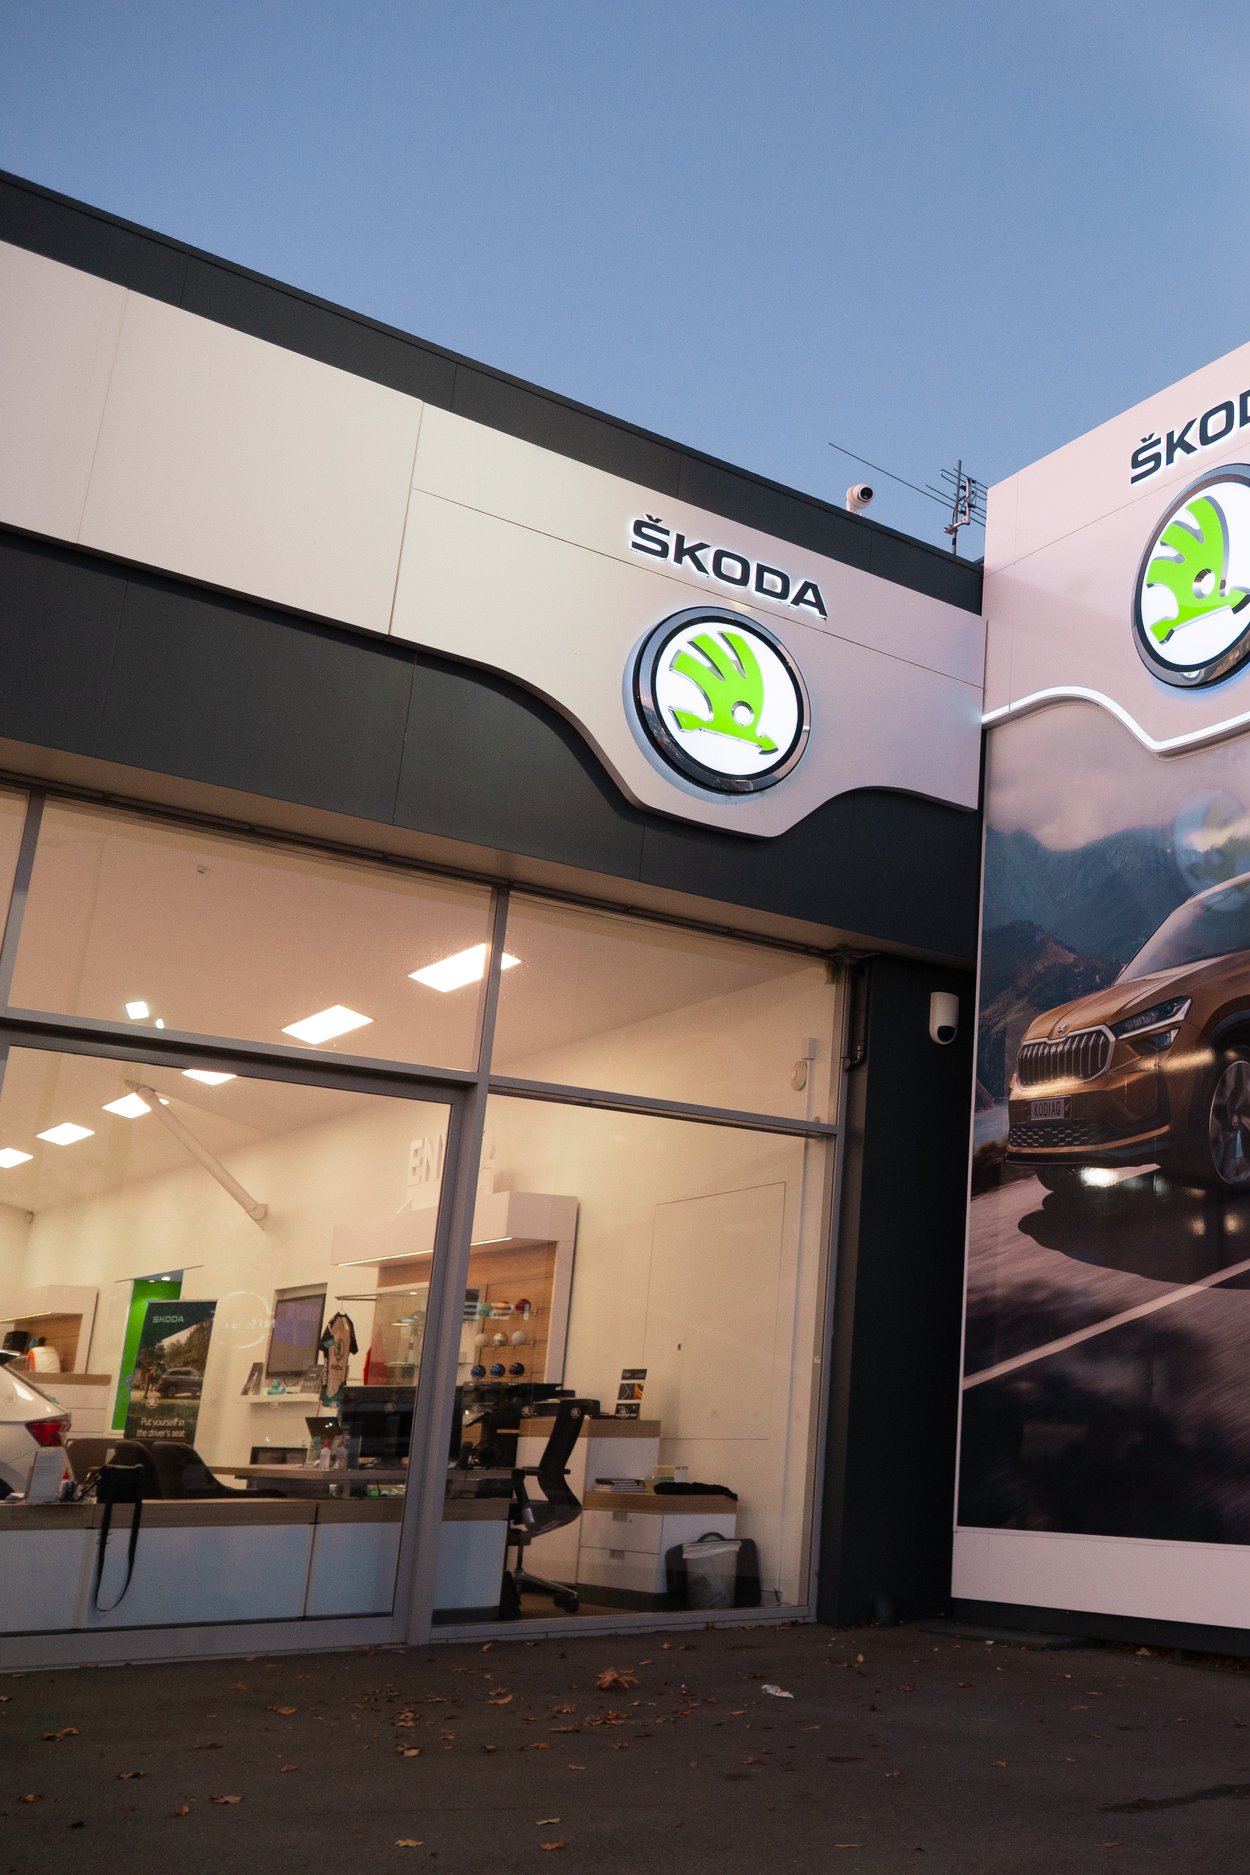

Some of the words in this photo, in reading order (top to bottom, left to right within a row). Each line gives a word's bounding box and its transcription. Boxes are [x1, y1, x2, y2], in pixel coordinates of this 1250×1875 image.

[631, 514, 829, 620] ŠKODA
[1033, 1101, 1061, 1117] KODIAQ
[140, 1417, 151, 1426] Put
[153, 1417, 178, 1428] yourself
[136, 1429, 147, 1437] the
